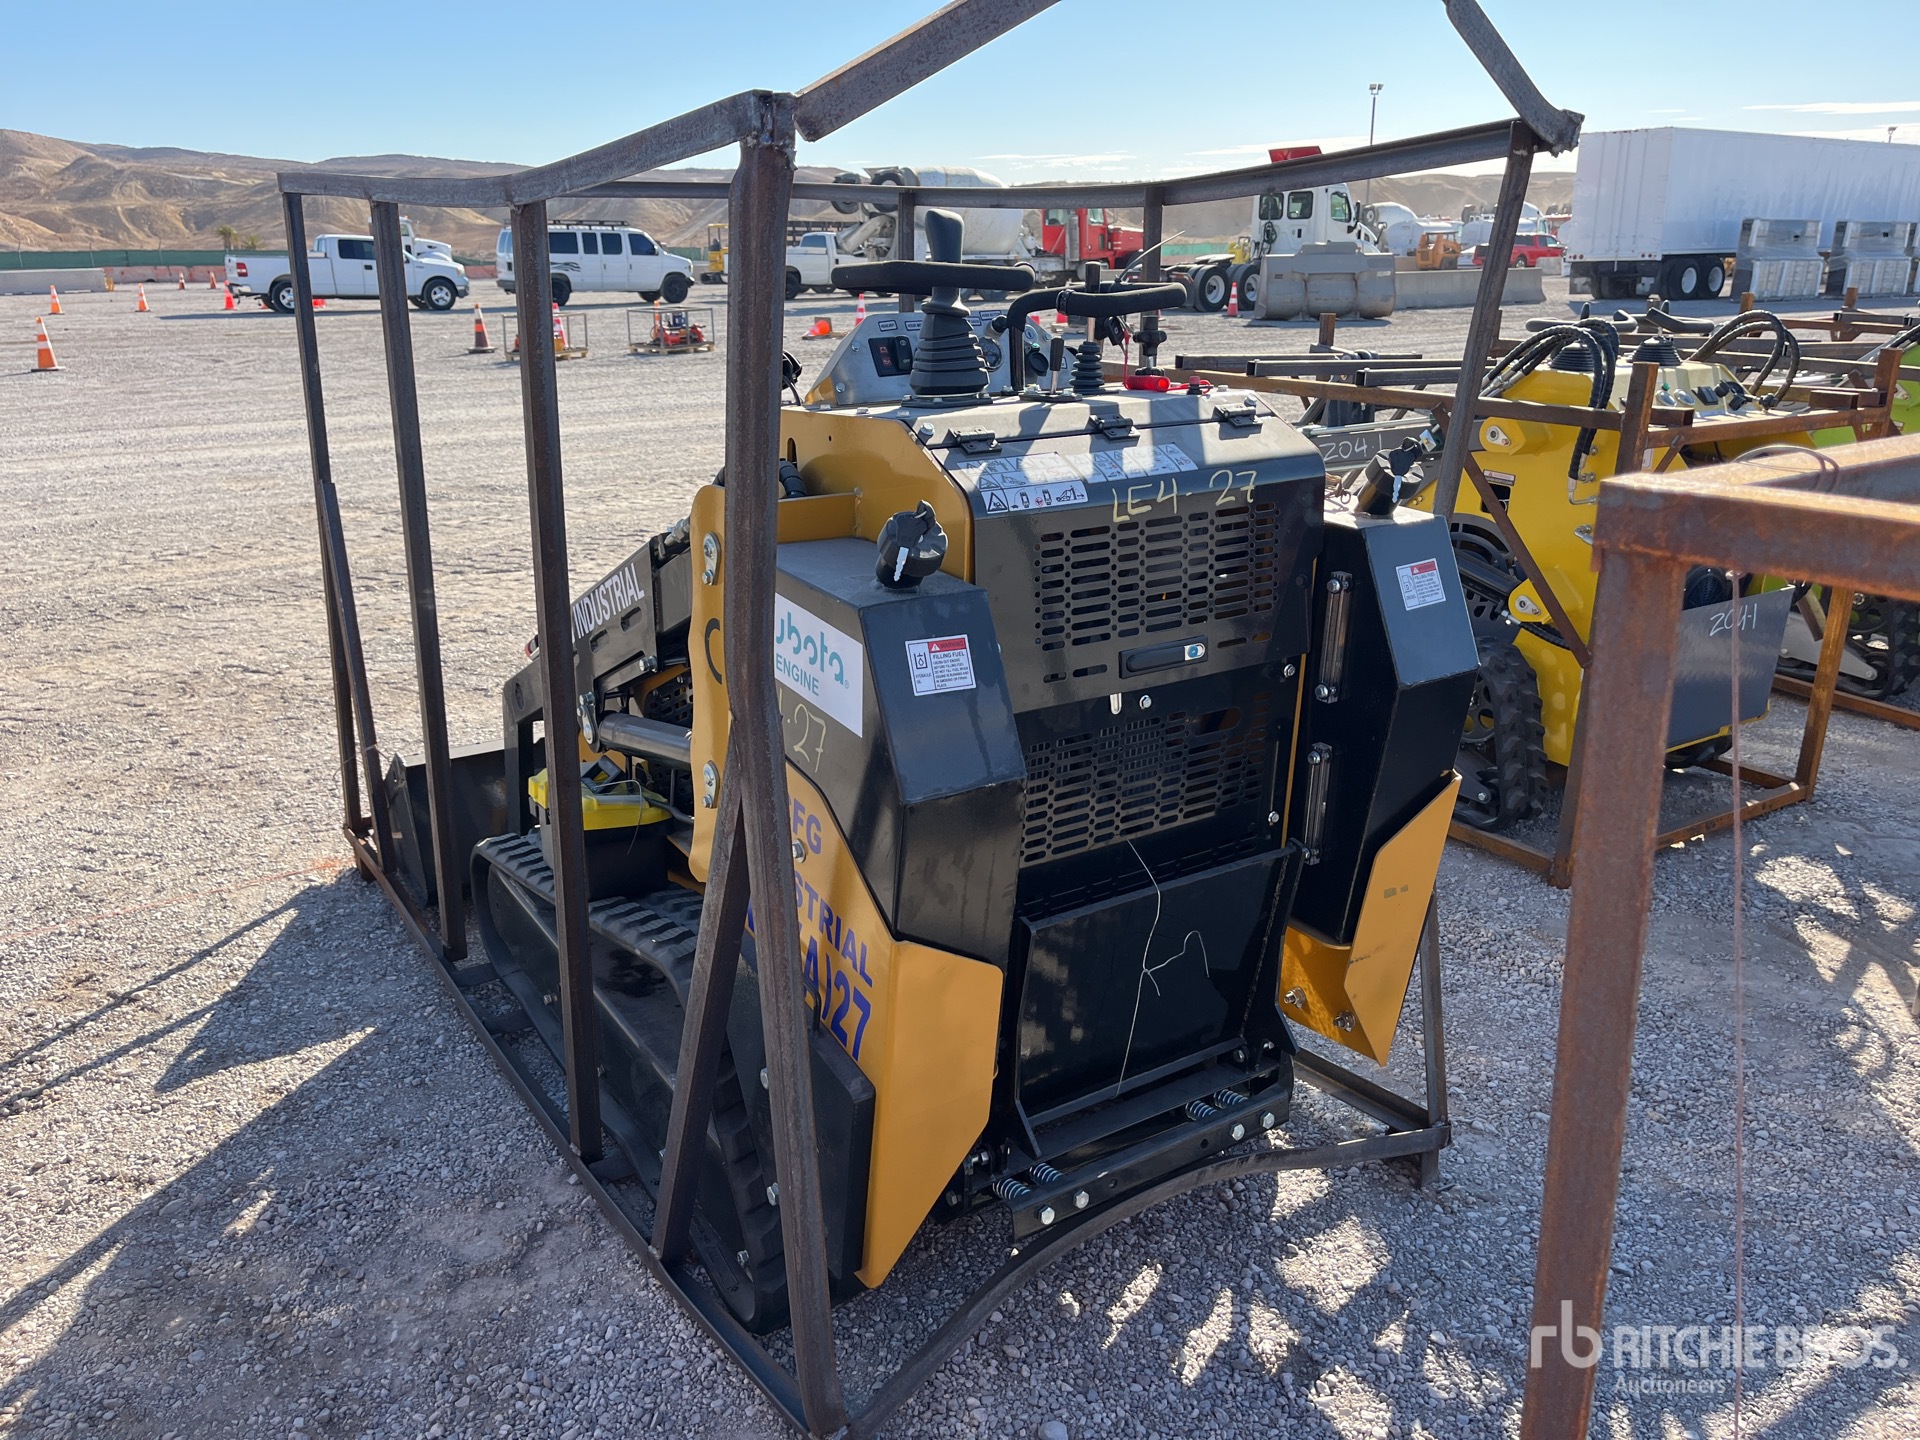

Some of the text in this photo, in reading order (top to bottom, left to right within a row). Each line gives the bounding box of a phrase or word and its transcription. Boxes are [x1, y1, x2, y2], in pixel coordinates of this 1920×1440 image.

[573, 563, 645, 639] INDUSTRIAL
[776, 653, 819, 696] ENGINE
[789, 794, 822, 856] FG
